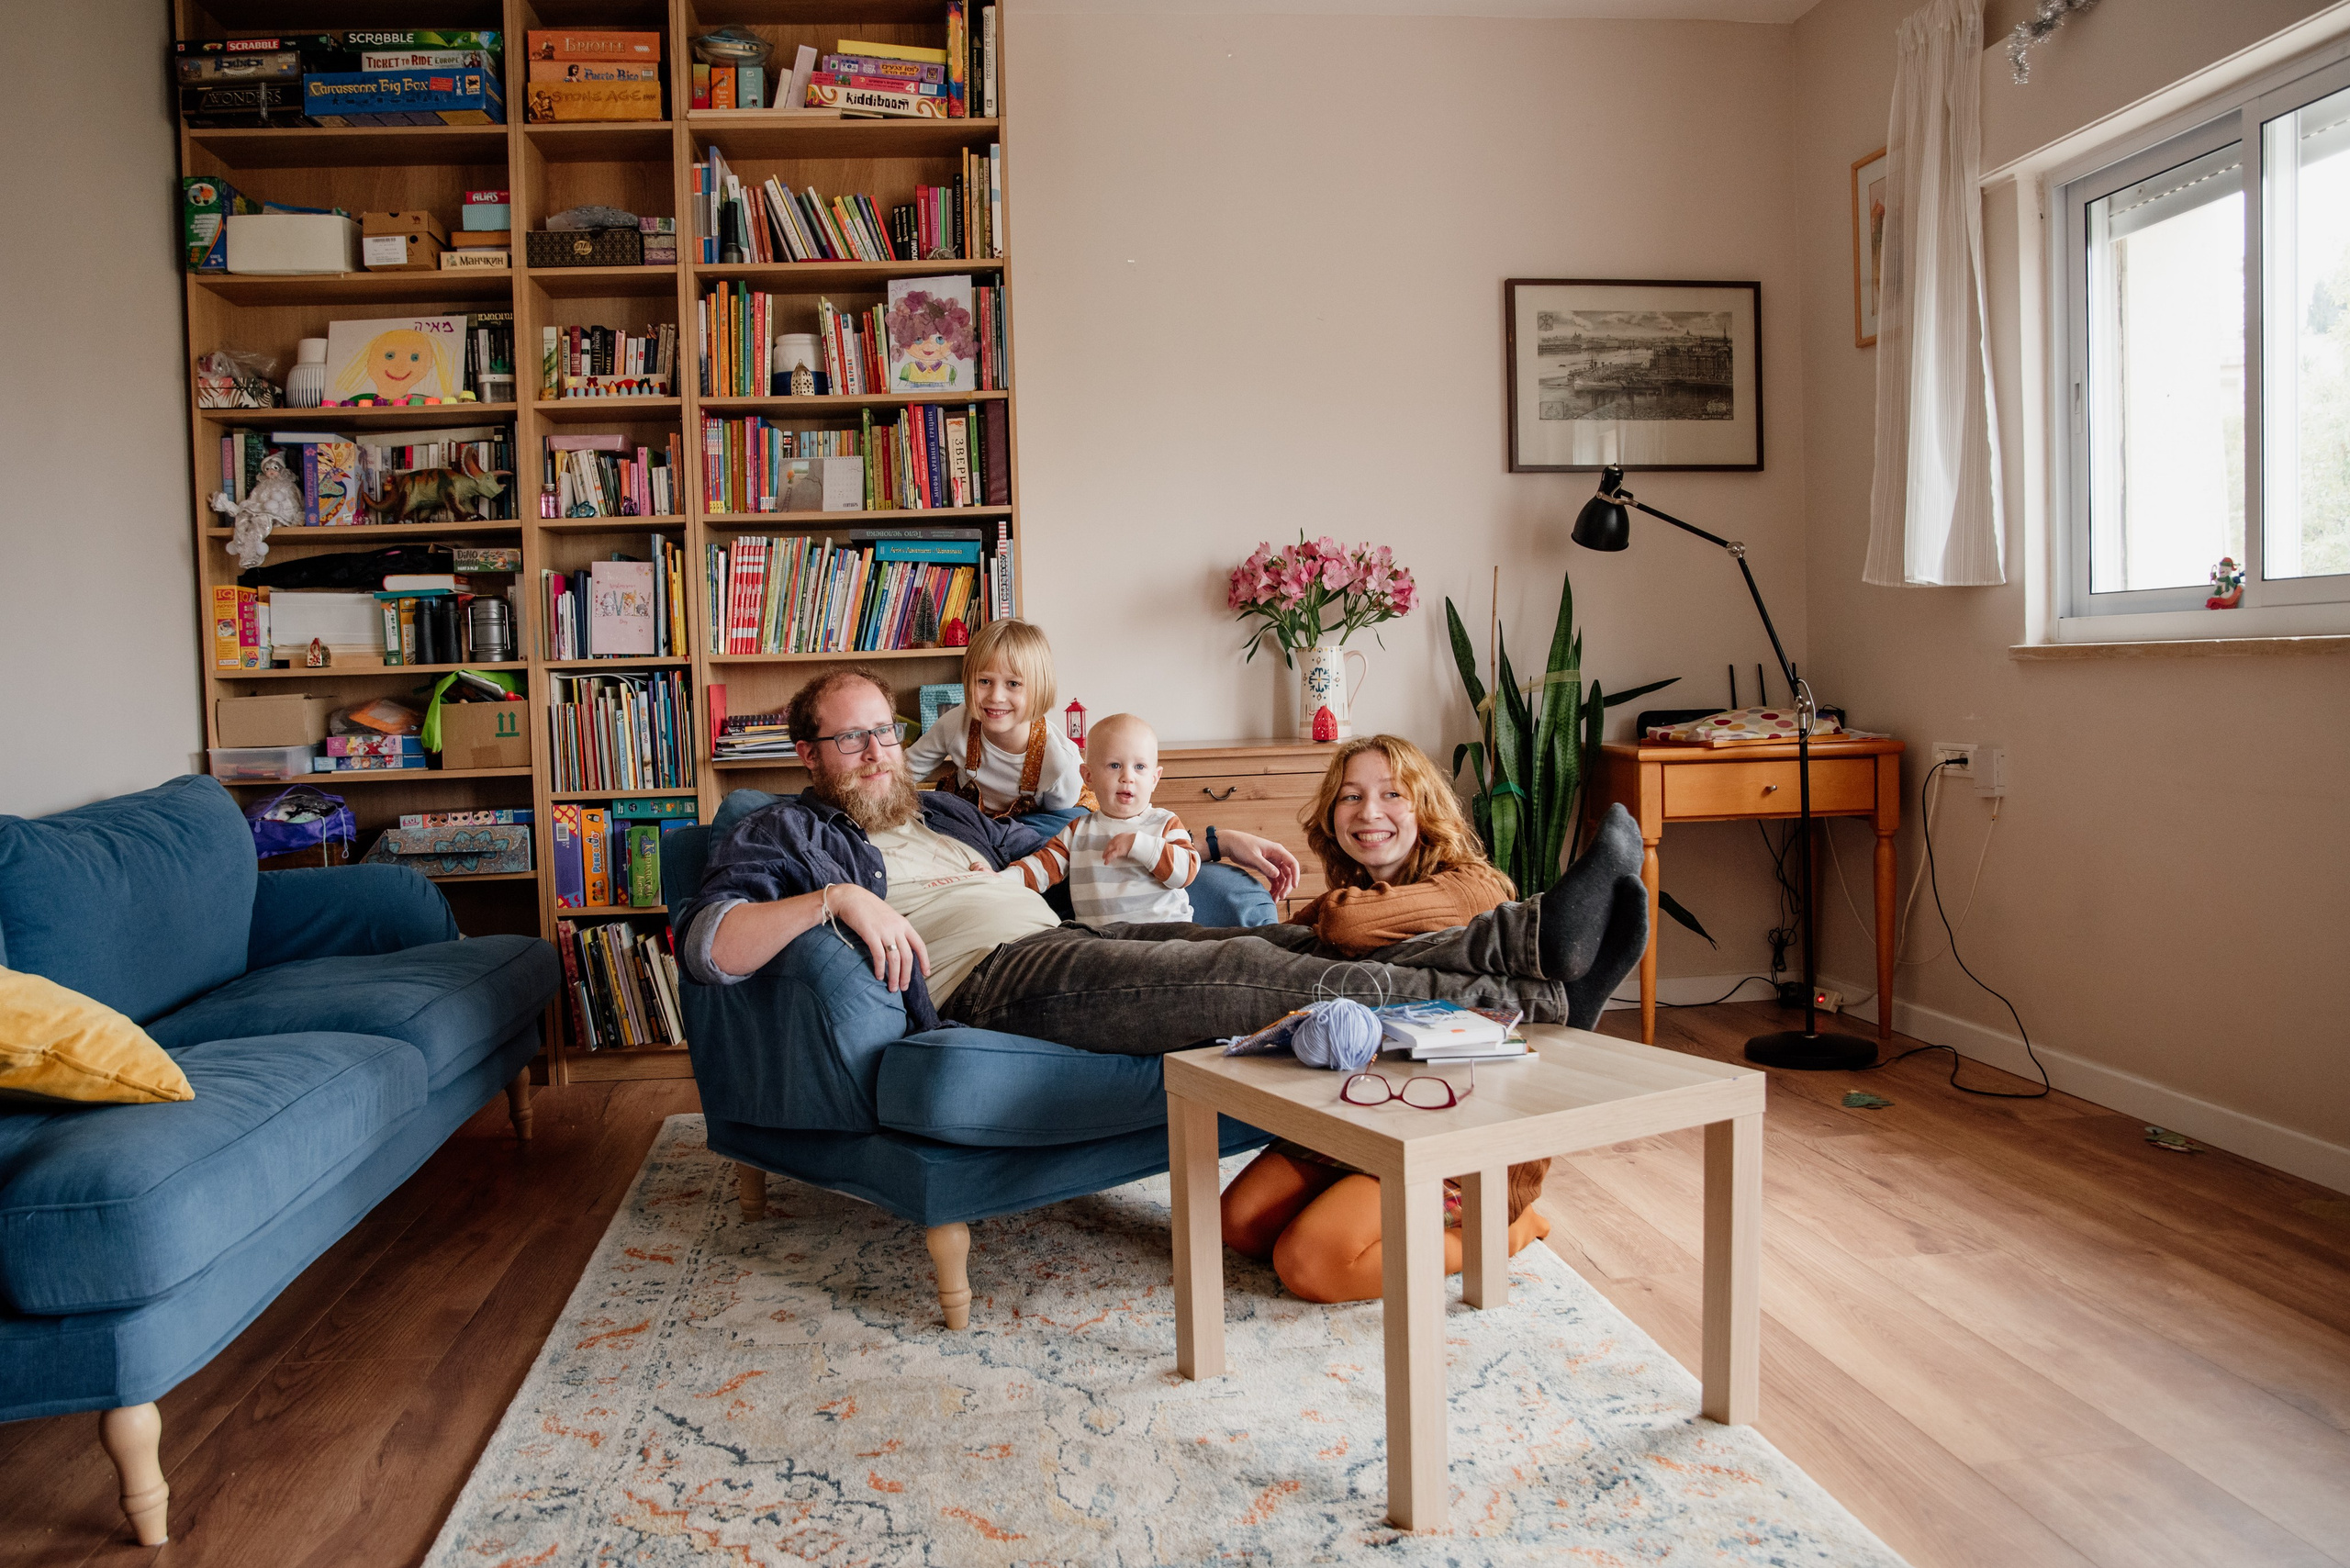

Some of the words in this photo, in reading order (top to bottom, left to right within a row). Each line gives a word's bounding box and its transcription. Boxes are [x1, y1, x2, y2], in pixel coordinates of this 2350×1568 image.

[229, 40, 279, 50] SCRABBLE
[349, 33, 415, 46] SCRABBLE
[564, 38, 626, 52] БРЮГГЕ
[584, 68, 615, 81] Puerto
[617, 68, 639, 81] Rico
[308, 81, 377, 96] Carcassonne
[379, 79, 402, 95] Big
[404, 78, 429, 92] Box
[905, 83, 916, 93] 4
[551, 91, 602, 103] STONE
[605, 90, 641, 102] AGE
[846, 92, 909, 110] kiddiboom
[459, 256, 504, 267] Манчкин
[414, 319, 455, 333] מאיה
[846, 358, 855, 381] МАРШАК
[217, 589, 235, 599] IQ
[240, 591, 249, 602] IQ
